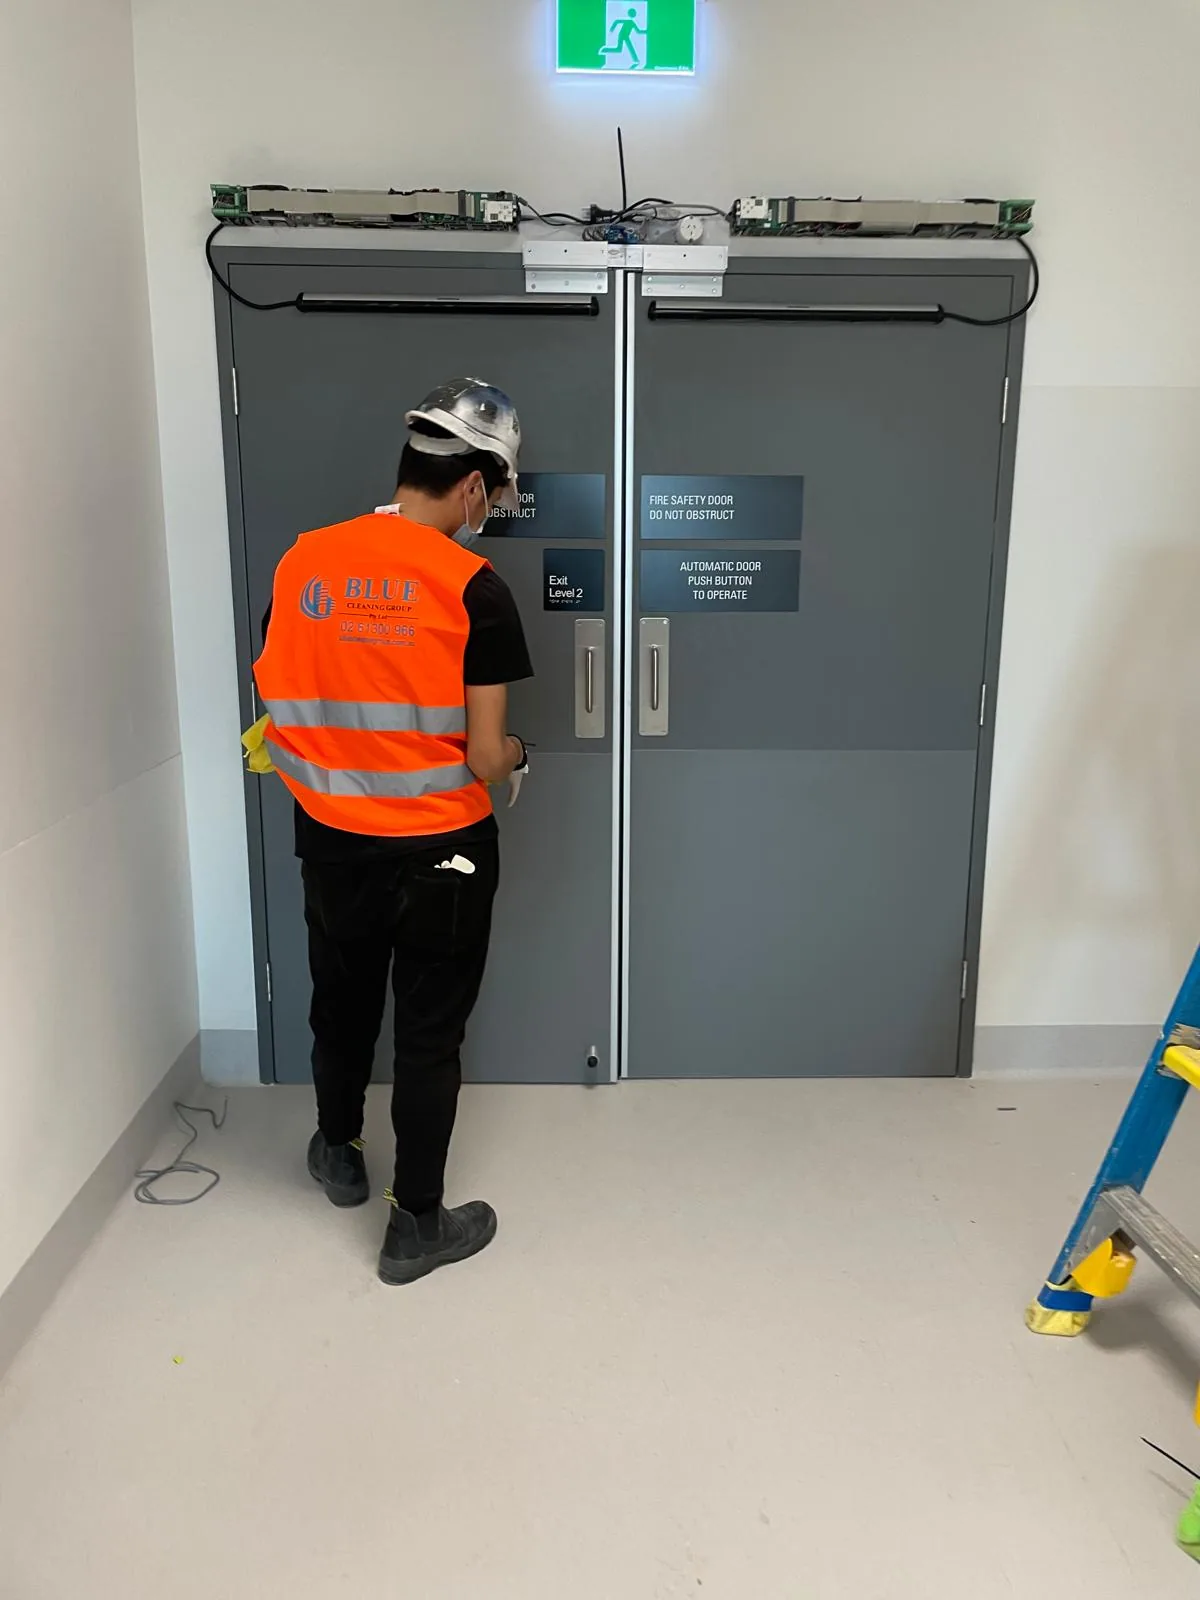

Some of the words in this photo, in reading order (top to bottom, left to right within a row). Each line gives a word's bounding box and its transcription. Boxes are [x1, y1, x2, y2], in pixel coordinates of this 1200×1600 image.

[649, 495, 669, 505] FIRE
[671, 495, 706, 505] SAFETY
[708, 495, 734, 505] DOOR
[649, 510, 663, 520] DO
[664, 510, 684, 520] NOT
[686, 510, 735, 520] OBSTRUCT
[679, 561, 734, 571] AUTOMATIC
[736, 561, 762, 571] DOOR
[549, 575, 568, 585] Exit
[688, 575, 713, 586] PUSH
[714, 575, 753, 586] BUTTON
[344, 577, 419, 601] BLUE
[549, 587, 575, 598] Level
[576, 588, 583, 598] 2
[693, 590, 705, 600] TO
[707, 590, 748, 600] OPERATE
[346, 602, 385, 611] CLEANING
[386, 604, 412, 613] GROUP
[341, 621, 354, 632] 02
[395, 625, 415, 636] 966
